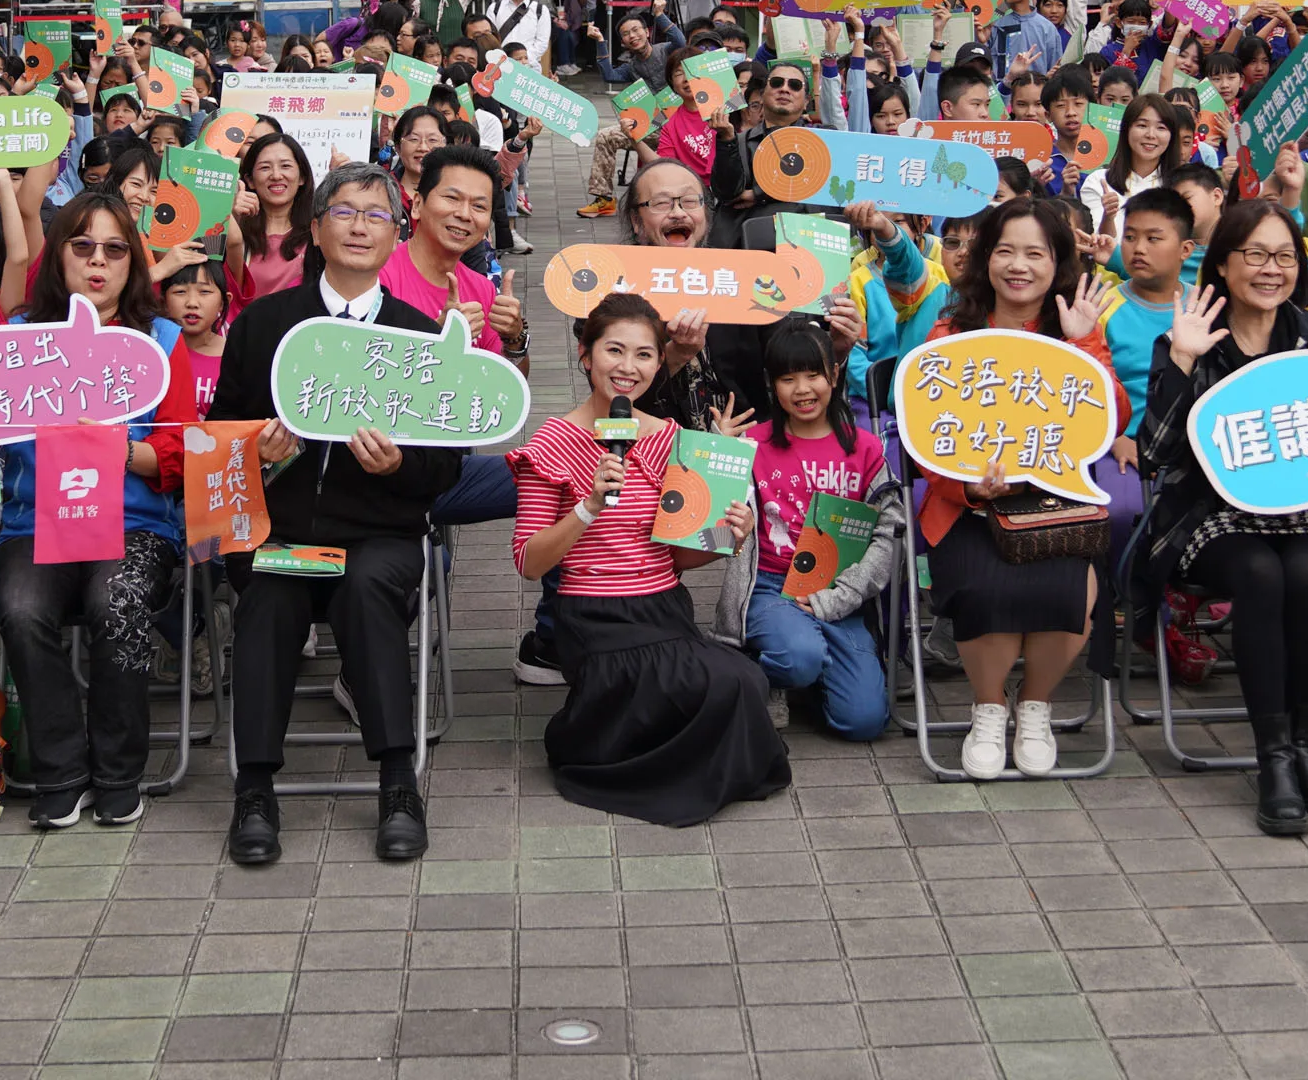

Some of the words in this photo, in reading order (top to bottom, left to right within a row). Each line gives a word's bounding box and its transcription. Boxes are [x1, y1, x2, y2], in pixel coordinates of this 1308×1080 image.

[12, 108, 52, 127] Life
[268, 96, 326, 114] 燕飛鄉
[952, 130, 1011, 145] 新竹縣立
[856, 153, 927, 187] 記得
[649, 266, 740, 298] 五色鳥
[362, 337, 443, 386] 客語
[295, 373, 503, 433] 新校歌運動
[915, 350, 1105, 418] 客語校歌
[928, 410, 1075, 476] 當好聽
[207, 470, 225, 511] 唱出
[224, 437, 253, 543] 新時代个聲
[801, 459, 862, 497] Hakka
